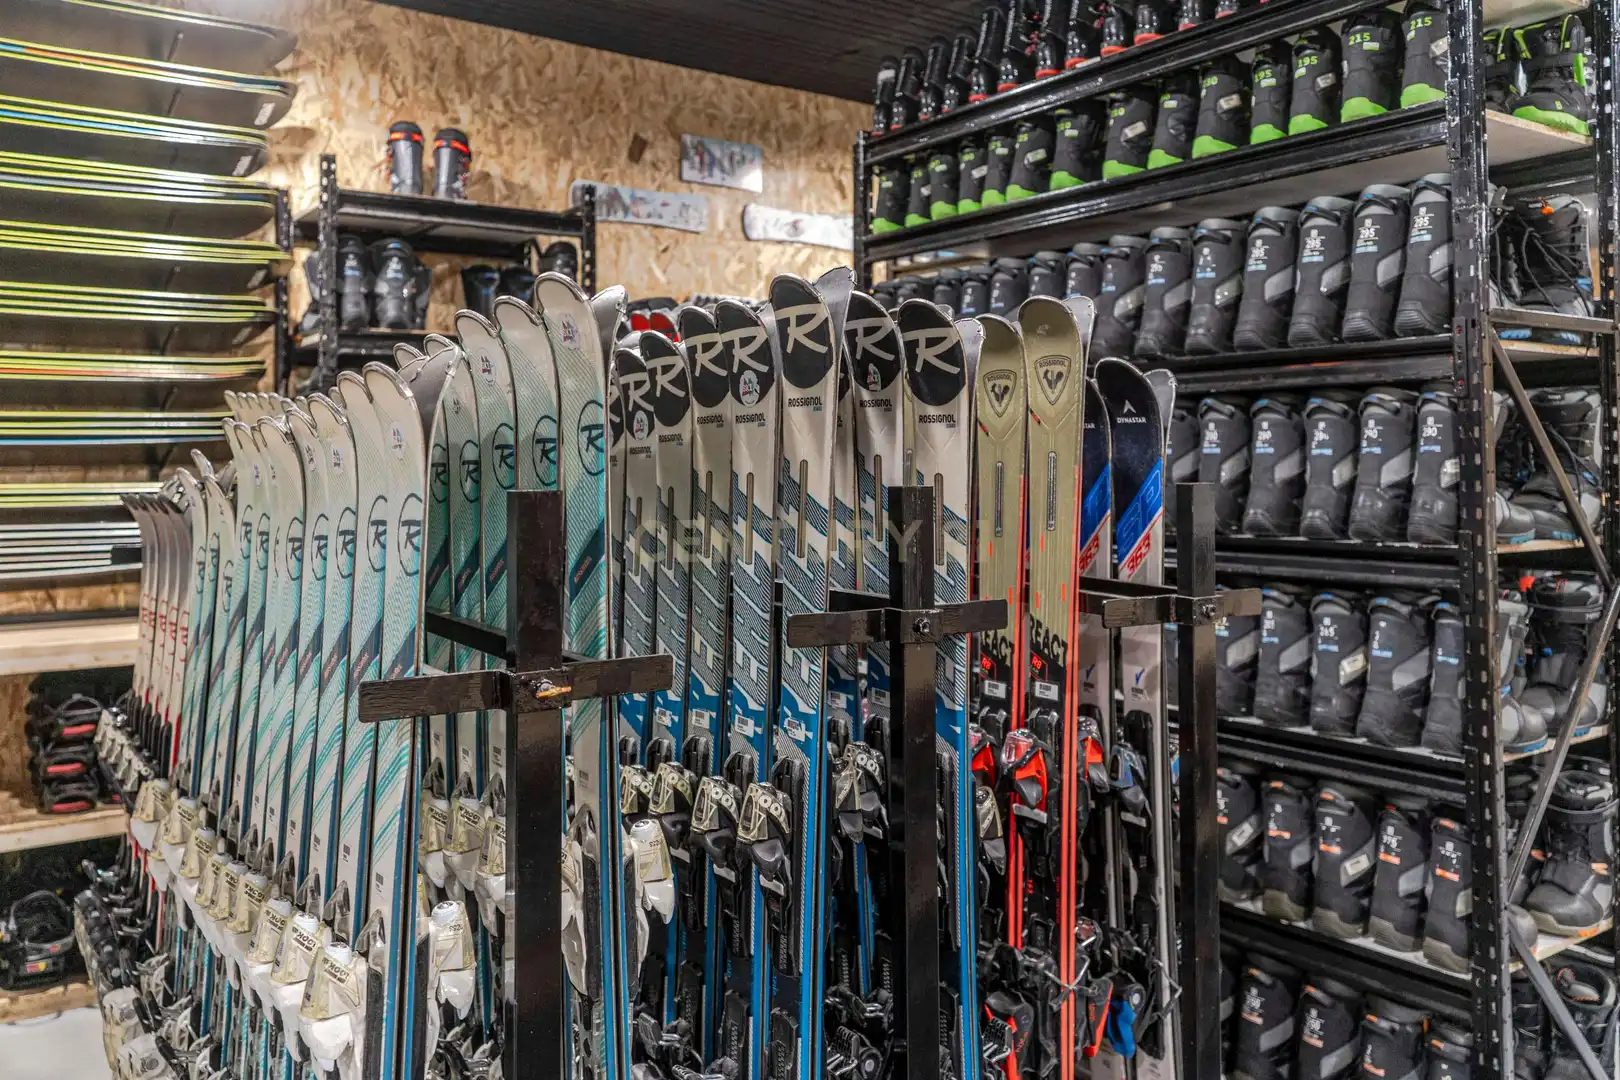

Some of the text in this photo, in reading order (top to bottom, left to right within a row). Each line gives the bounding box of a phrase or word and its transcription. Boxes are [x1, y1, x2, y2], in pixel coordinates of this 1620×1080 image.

[1409, 17, 1432, 30] 215
[1348, 32, 1371, 46] 215
[1297, 56, 1318, 68] 195
[775, 303, 831, 354] R
[847, 318, 895, 361] R
[685, 333, 727, 377] R
[720, 327, 769, 373] R
[902, 327, 961, 374] R
[648, 356, 686, 399] R
[787, 396, 823, 407] ROSSIGNOL
[859, 398, 893, 408] ROSSIGNOL
[696, 416, 724, 425] ROSSIGNOL
[735, 413, 766, 424] ROSSIGNOL
[918, 414, 957, 424] ROSSIGNOL
[297, 932, 316, 948] LOOK
[328, 962, 350, 980] LOOK
